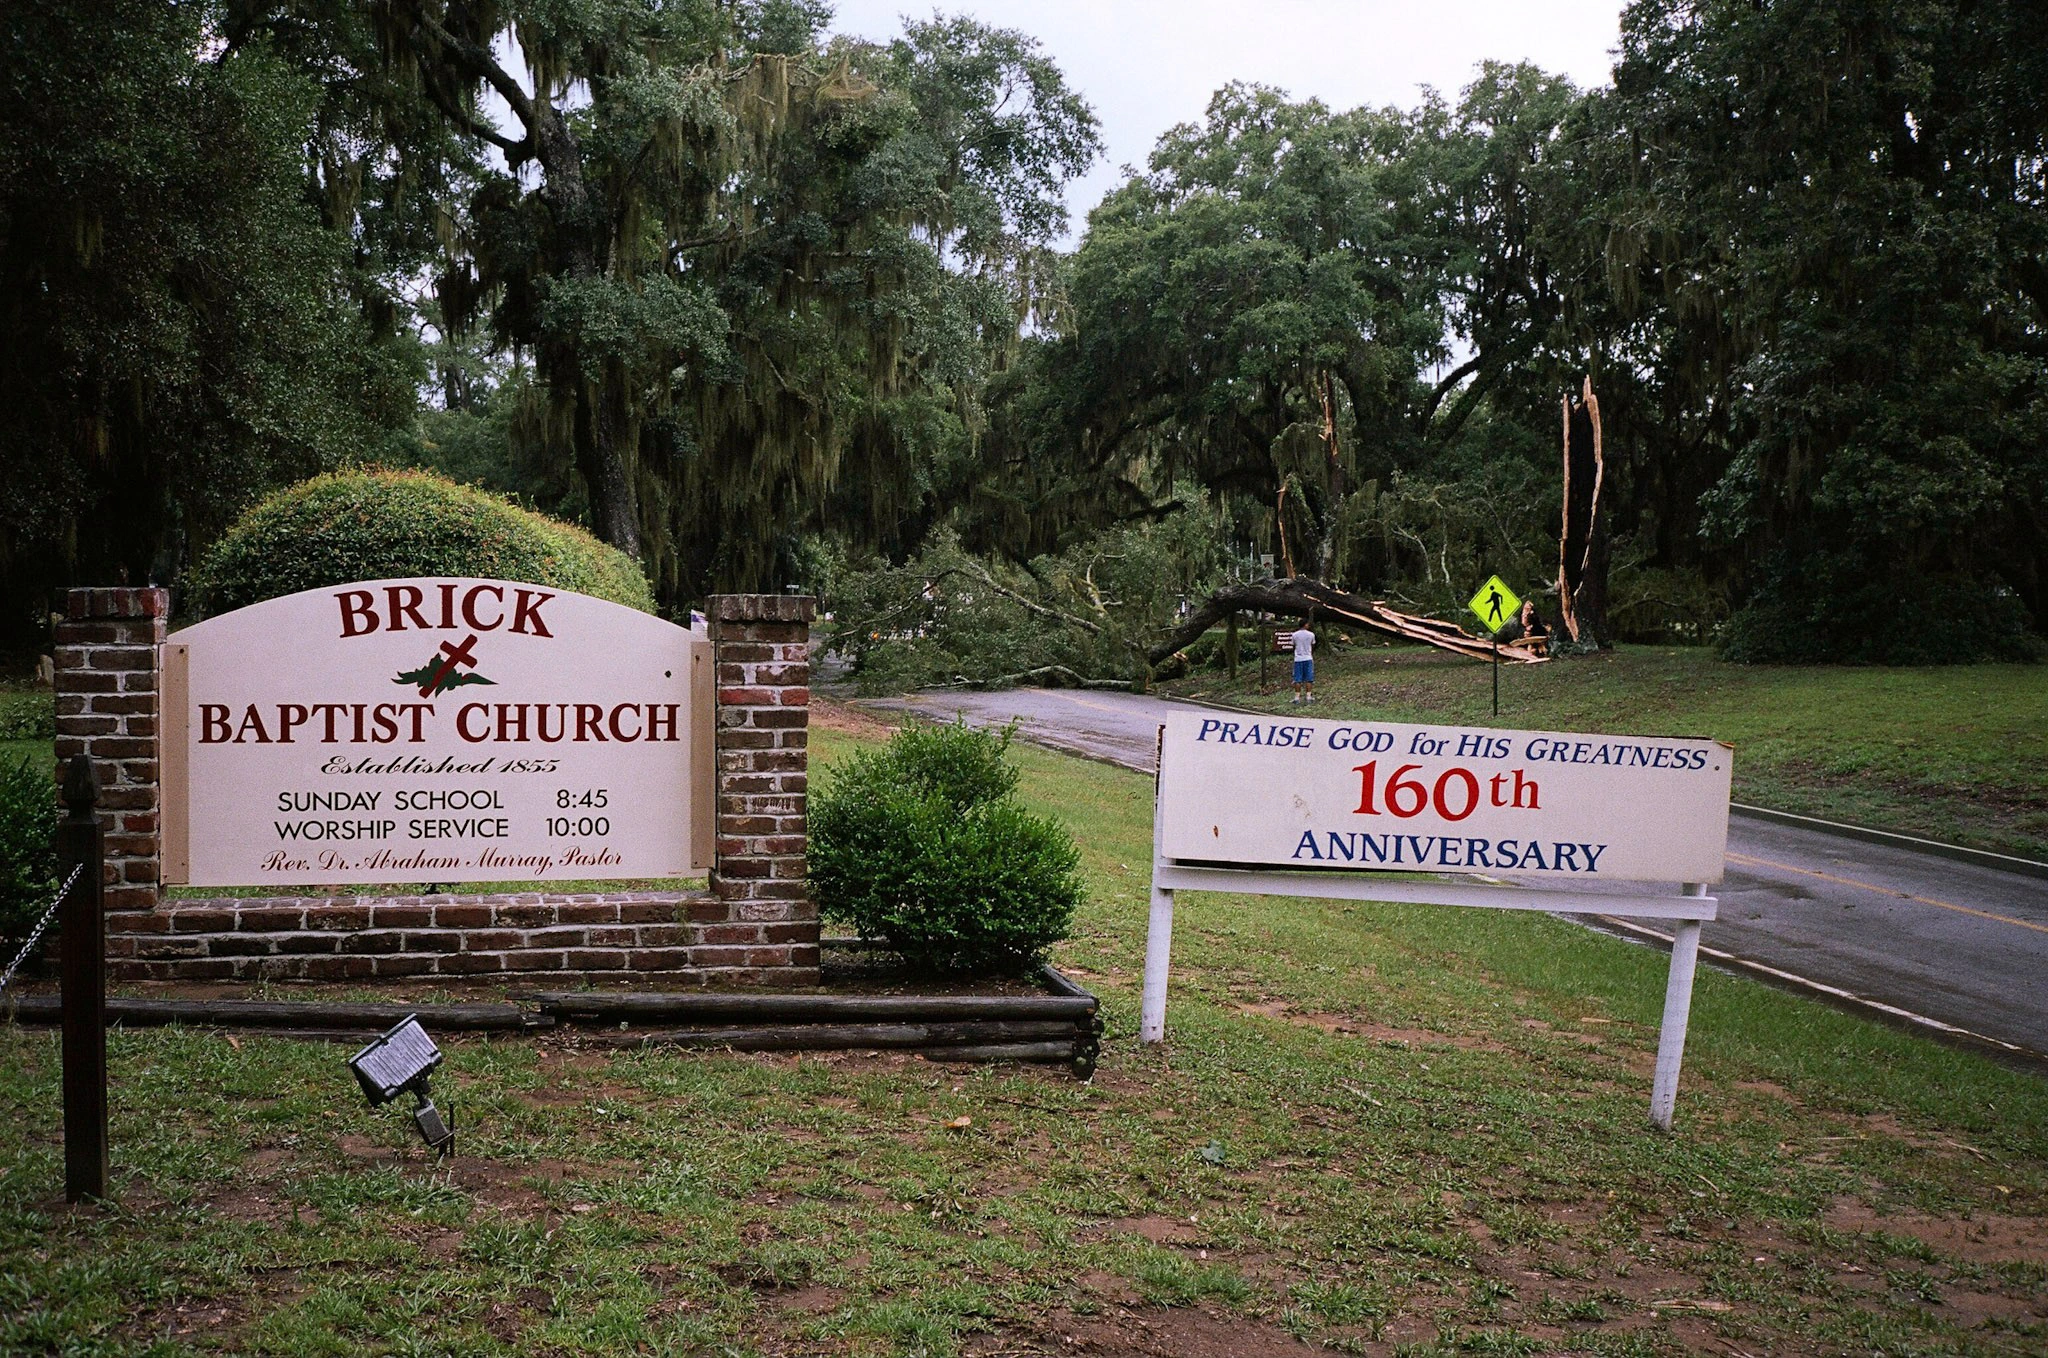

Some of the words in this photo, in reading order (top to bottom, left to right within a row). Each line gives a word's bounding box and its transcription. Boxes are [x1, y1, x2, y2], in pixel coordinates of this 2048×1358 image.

[333, 584, 556, 639] BRICK
[197, 703, 435, 744] BAPTIST
[456, 702, 681, 744] CHURCH
[1196, 718, 1314, 749] PRAISE
[1328, 727, 1394, 753] GOD
[1408, 731, 1450, 757] for
[1455, 734, 1510, 760] HIS
[1525, 738, 1708, 770] GREATNESS
[320, 756, 492, 775] Established
[497, 759, 561, 774] 1855
[277, 791, 382, 812] SUNDAY
[394, 790, 505, 811] SCHOOL
[556, 789, 609, 809] 8:45
[1352, 759, 1542, 822] 160th
[274, 820, 396, 840] WORSHIP
[408, 818, 509, 839] SERVICE
[546, 817, 610, 837] 10:00
[260, 850, 311, 872] Rev.
[318, 850, 350, 871] Dr.
[355, 848, 460, 870] Abraham
[465, 847, 553, 876] Murray,
[558, 846, 623, 867] Pastor
[1292, 829, 1607, 873] ANNIVERSARY
